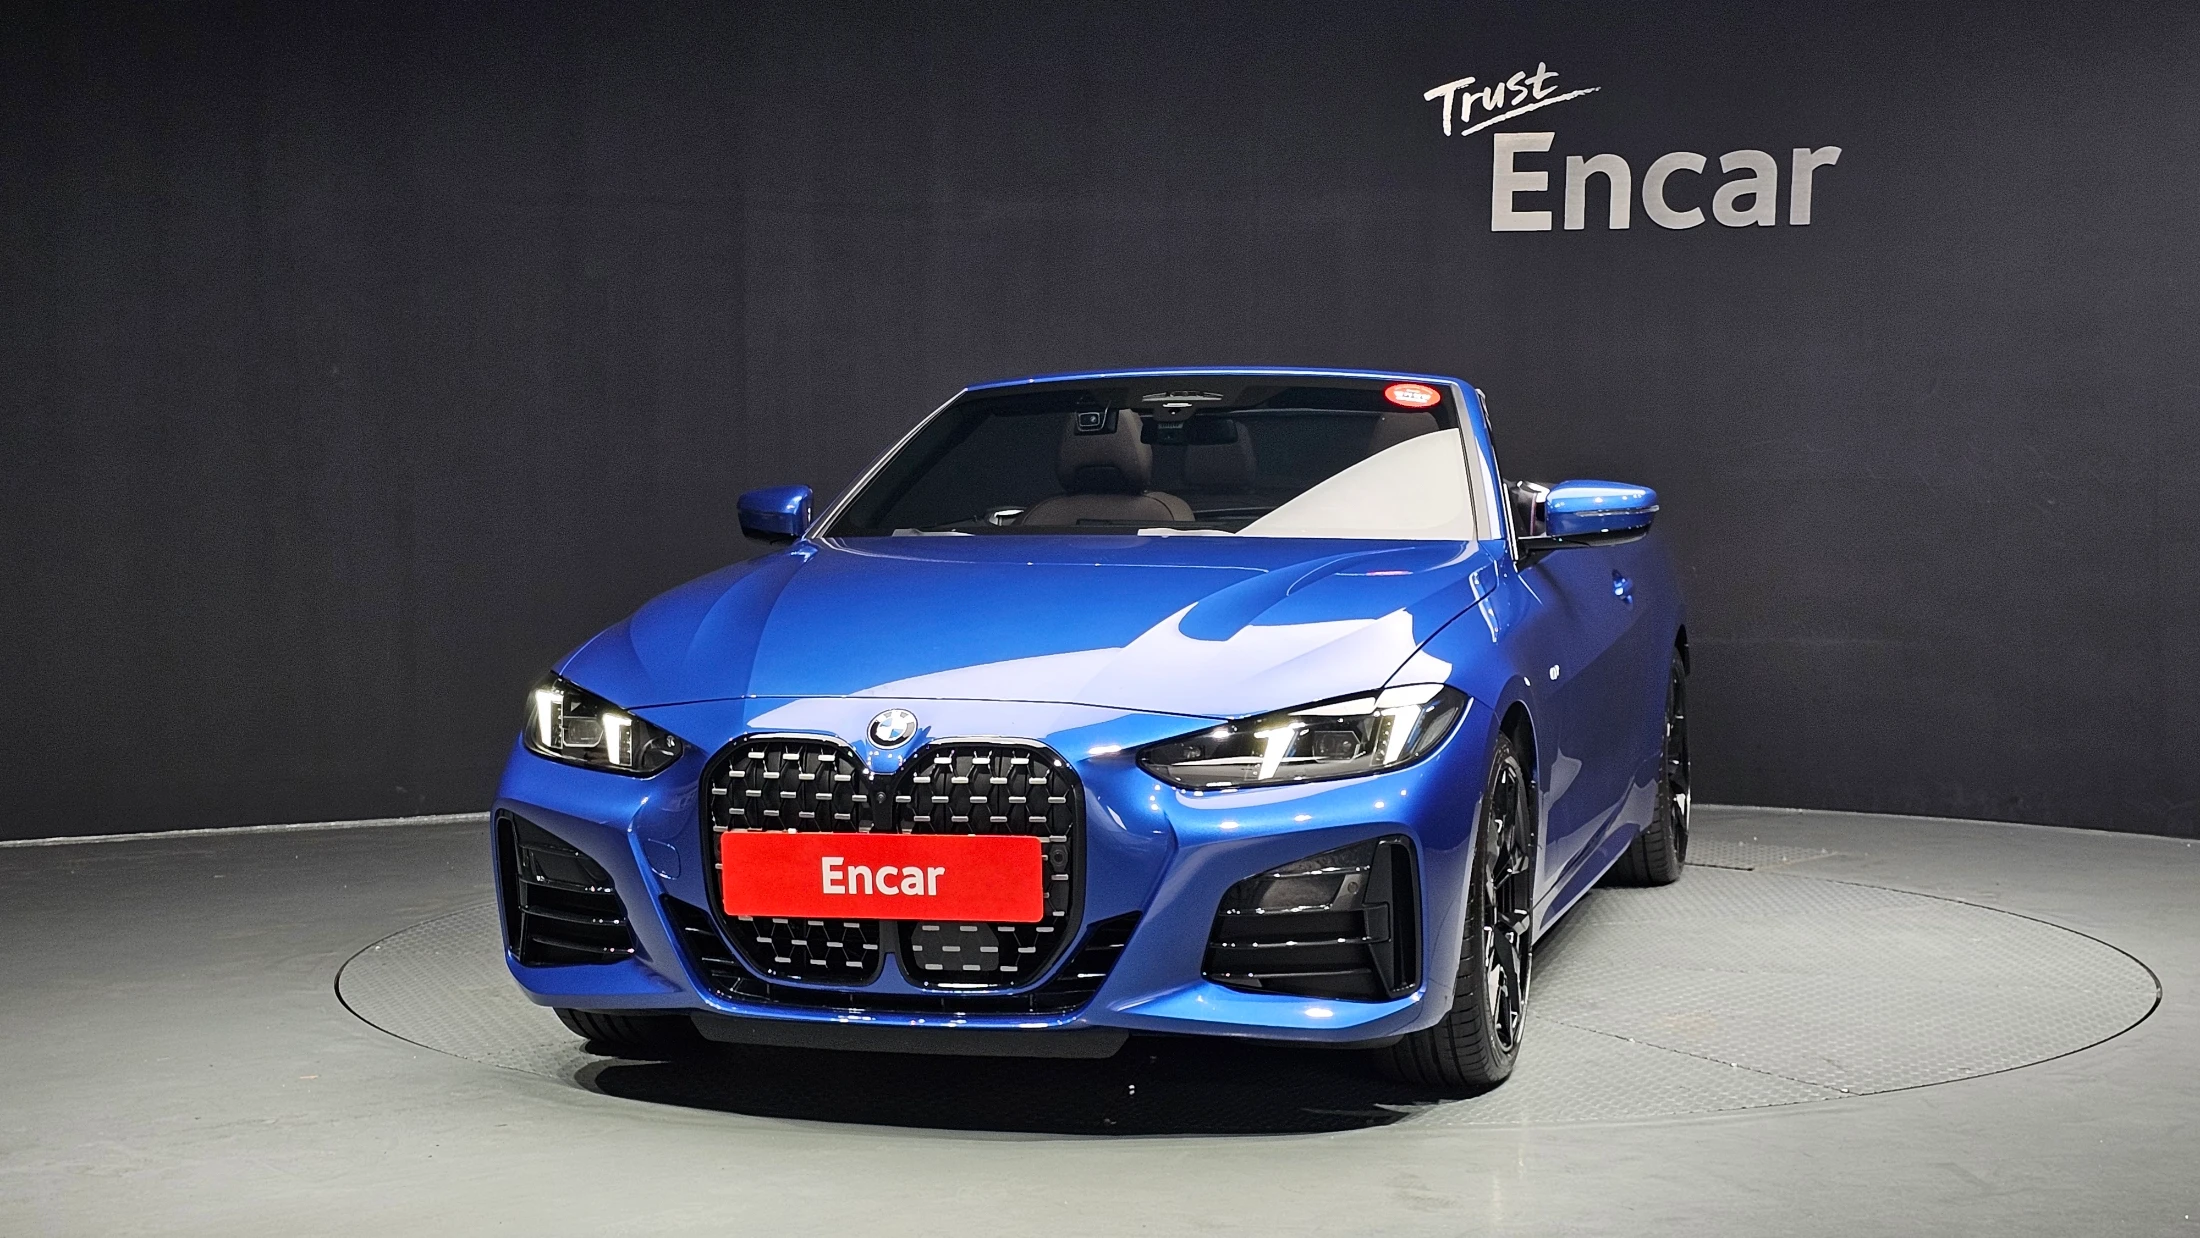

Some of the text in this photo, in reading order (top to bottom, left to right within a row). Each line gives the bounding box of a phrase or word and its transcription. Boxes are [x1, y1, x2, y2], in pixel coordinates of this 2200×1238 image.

[1424, 62, 1559, 136] Trust
[1491, 132, 1842, 231] Encar
[821, 856, 945, 896] Encar
